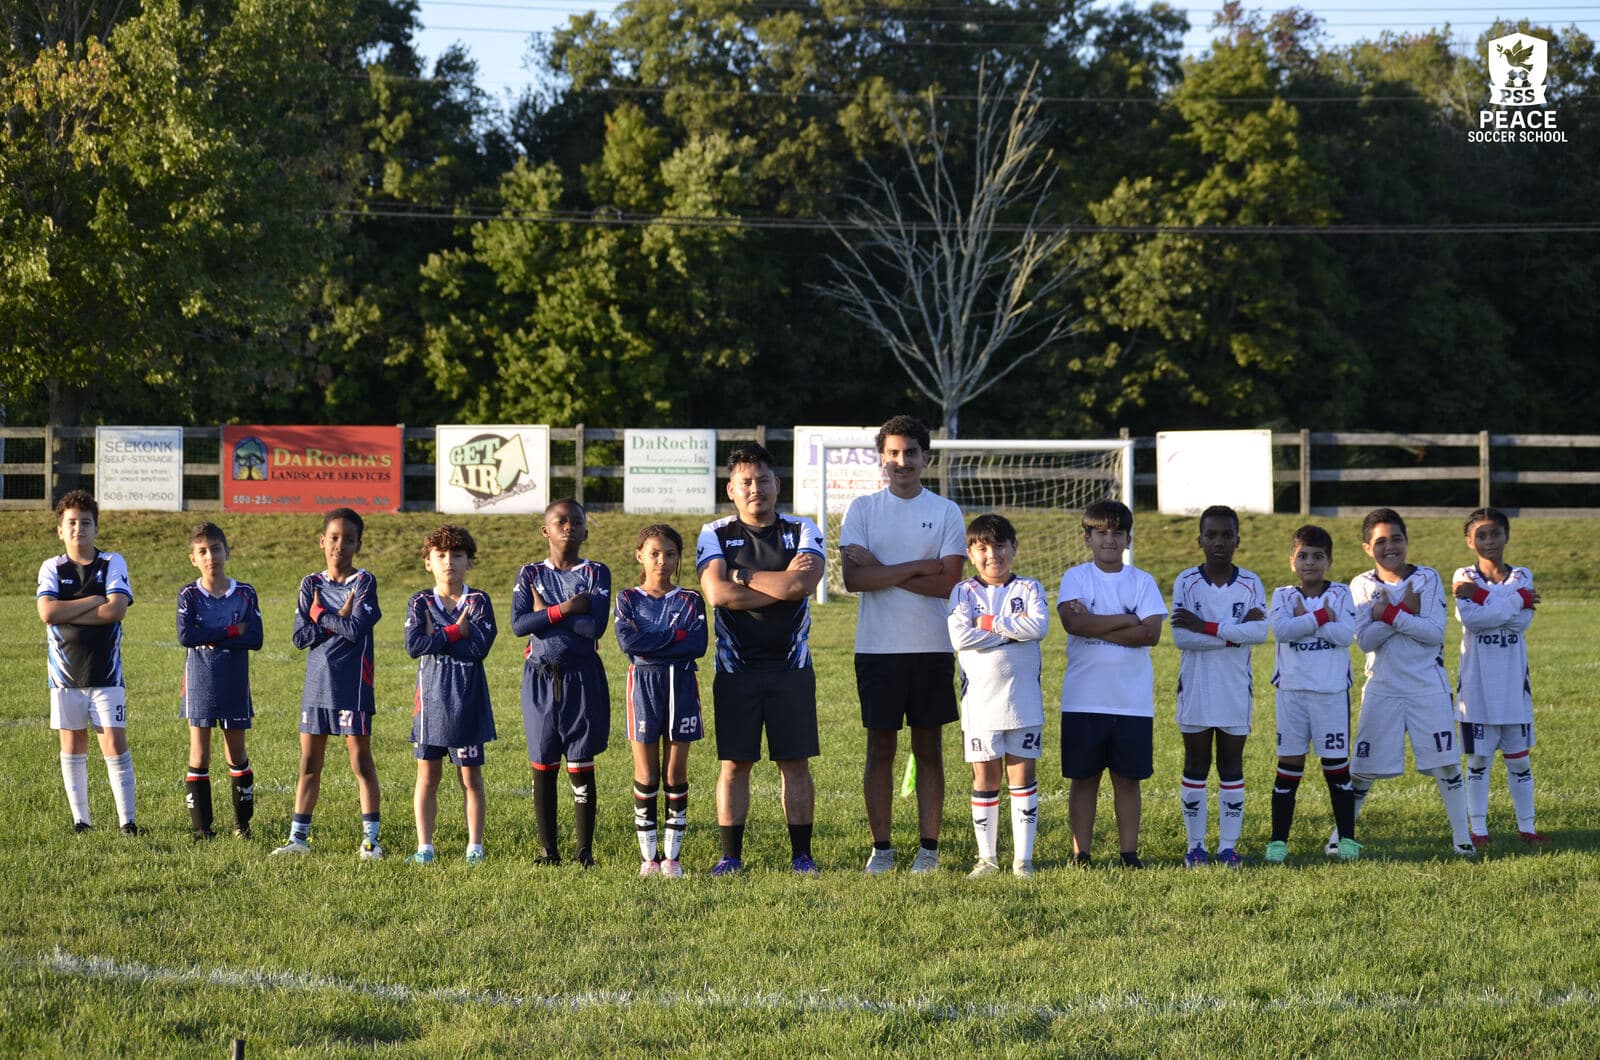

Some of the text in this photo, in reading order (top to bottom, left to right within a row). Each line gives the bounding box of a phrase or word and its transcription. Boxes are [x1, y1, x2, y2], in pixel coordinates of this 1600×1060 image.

[105, 440, 173, 453] SEEKONK
[632, 435, 708, 449] DaRocha
[104, 455, 174, 464] SELF-STORAGE
[449, 437, 500, 466] GET
[271, 471, 391, 480] LANDSCAPE SERVICES
[449, 464, 501, 496] AIR
[726, 539, 745, 548] PSS
[115, 704, 126, 722] 3
[338, 709, 354, 727] 27
[679, 716, 698, 734] 29
[1325, 732, 1345, 750] 25
[1433, 730, 1452, 753] 17
